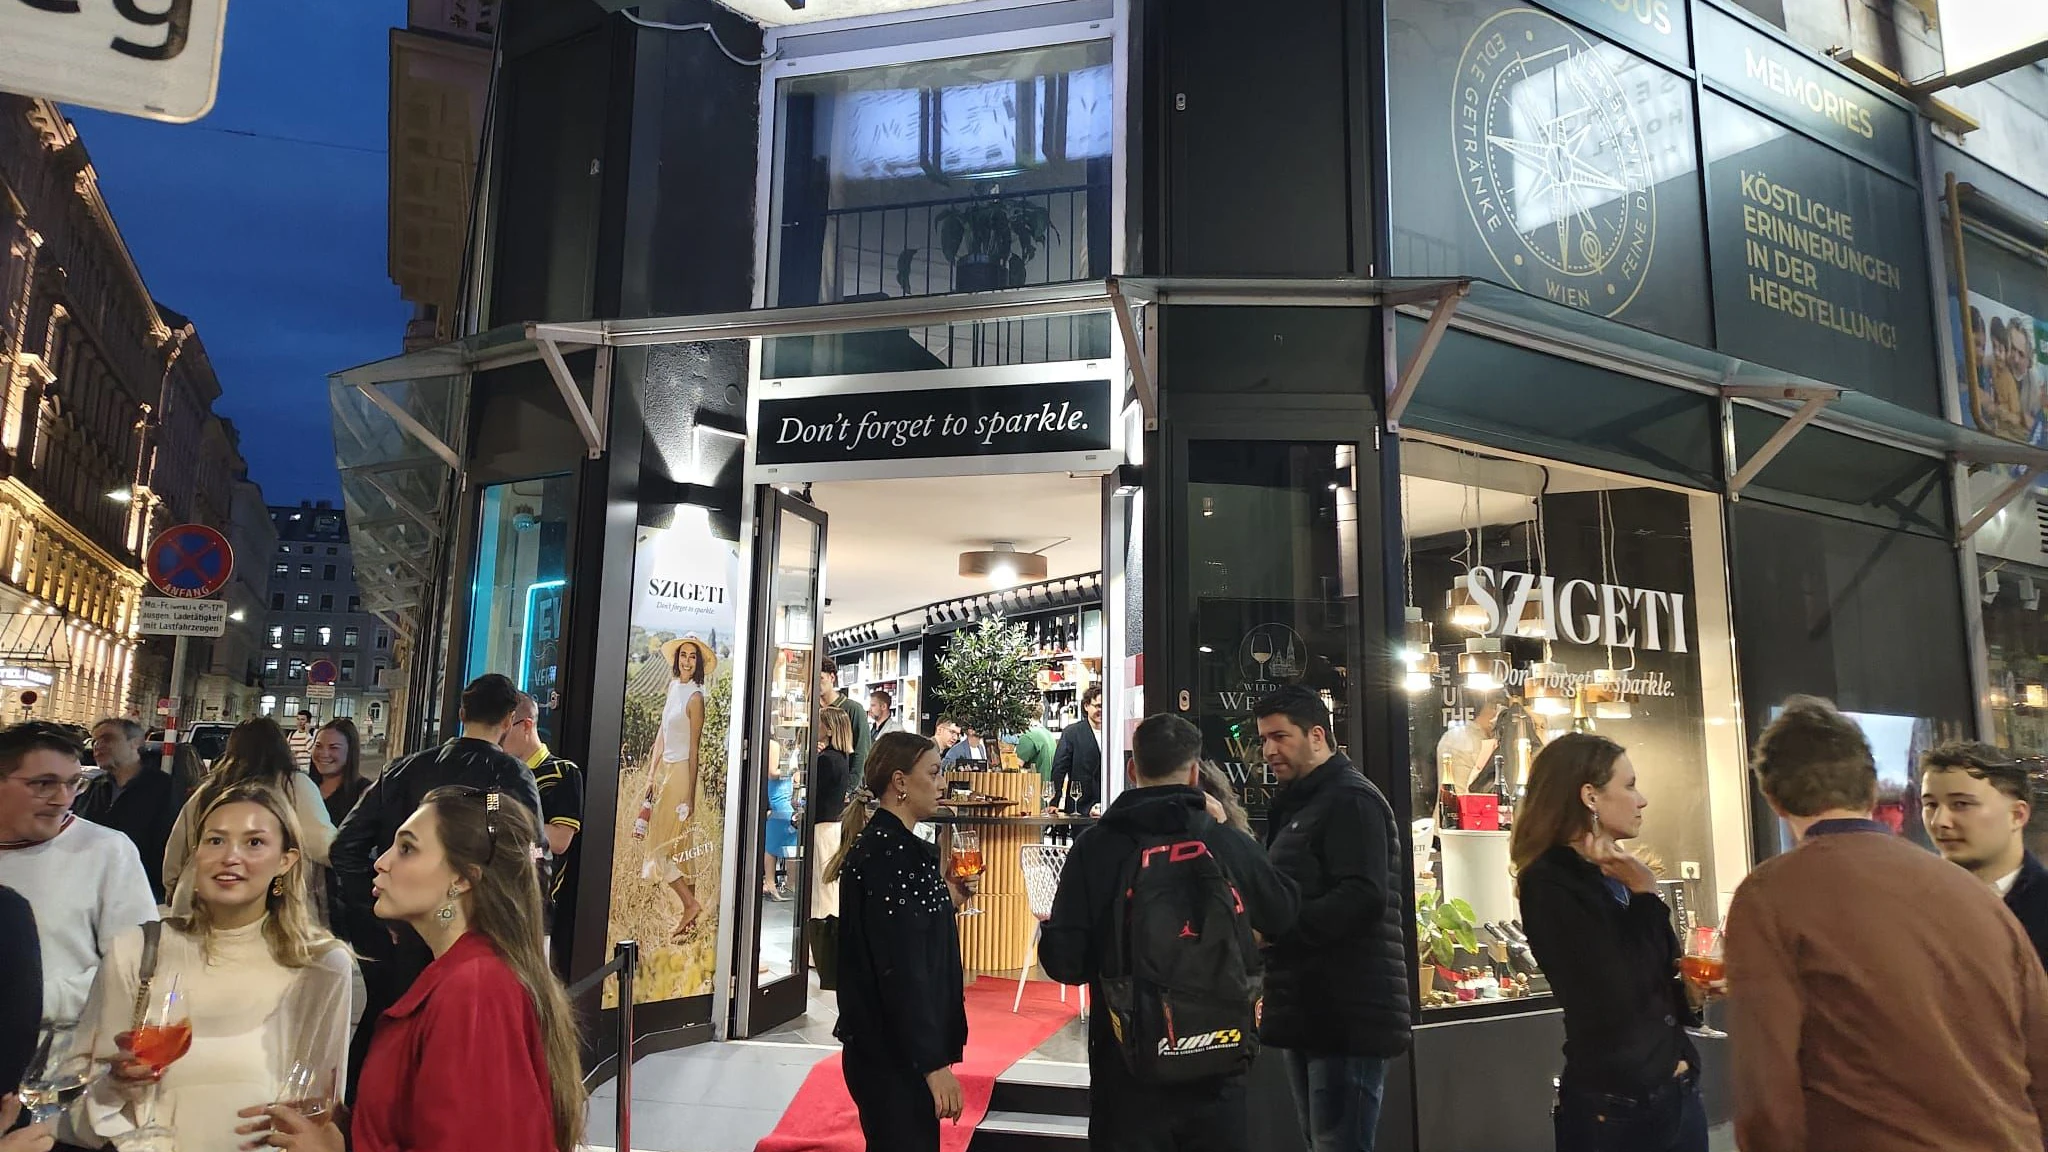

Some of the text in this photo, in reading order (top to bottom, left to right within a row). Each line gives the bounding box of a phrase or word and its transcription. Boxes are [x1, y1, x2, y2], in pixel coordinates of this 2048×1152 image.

[1745, 46, 1874, 139] MEMORIES
[1463, 33, 1507, 233] EDLE GETRÄNKE
[1740, 169, 1854, 241] KÖSTLICHE
[1621, 217, 1647, 281] FEINE
[1743, 204, 1900, 290] ERINNERUNGEN
[1746, 238, 1818, 290] IN DER
[1545, 278, 1591, 307] WIEN
[1749, 273, 1897, 350] HERSTELLUNG!
[776, 400, 1090, 451] Don't forget to sparkle.
[162, 583, 210, 598] ANFANG
[648, 578, 724, 604] SZIGETI
[1467, 566, 1688, 654] SZIGETI
[143, 621, 219, 633] mit Lastfahrzeugen
[173, 612, 223, 623] Ladetätigkeit
[1614, 670, 1675, 702] sparkle.
[672, 840, 714, 864] SZIGETI
